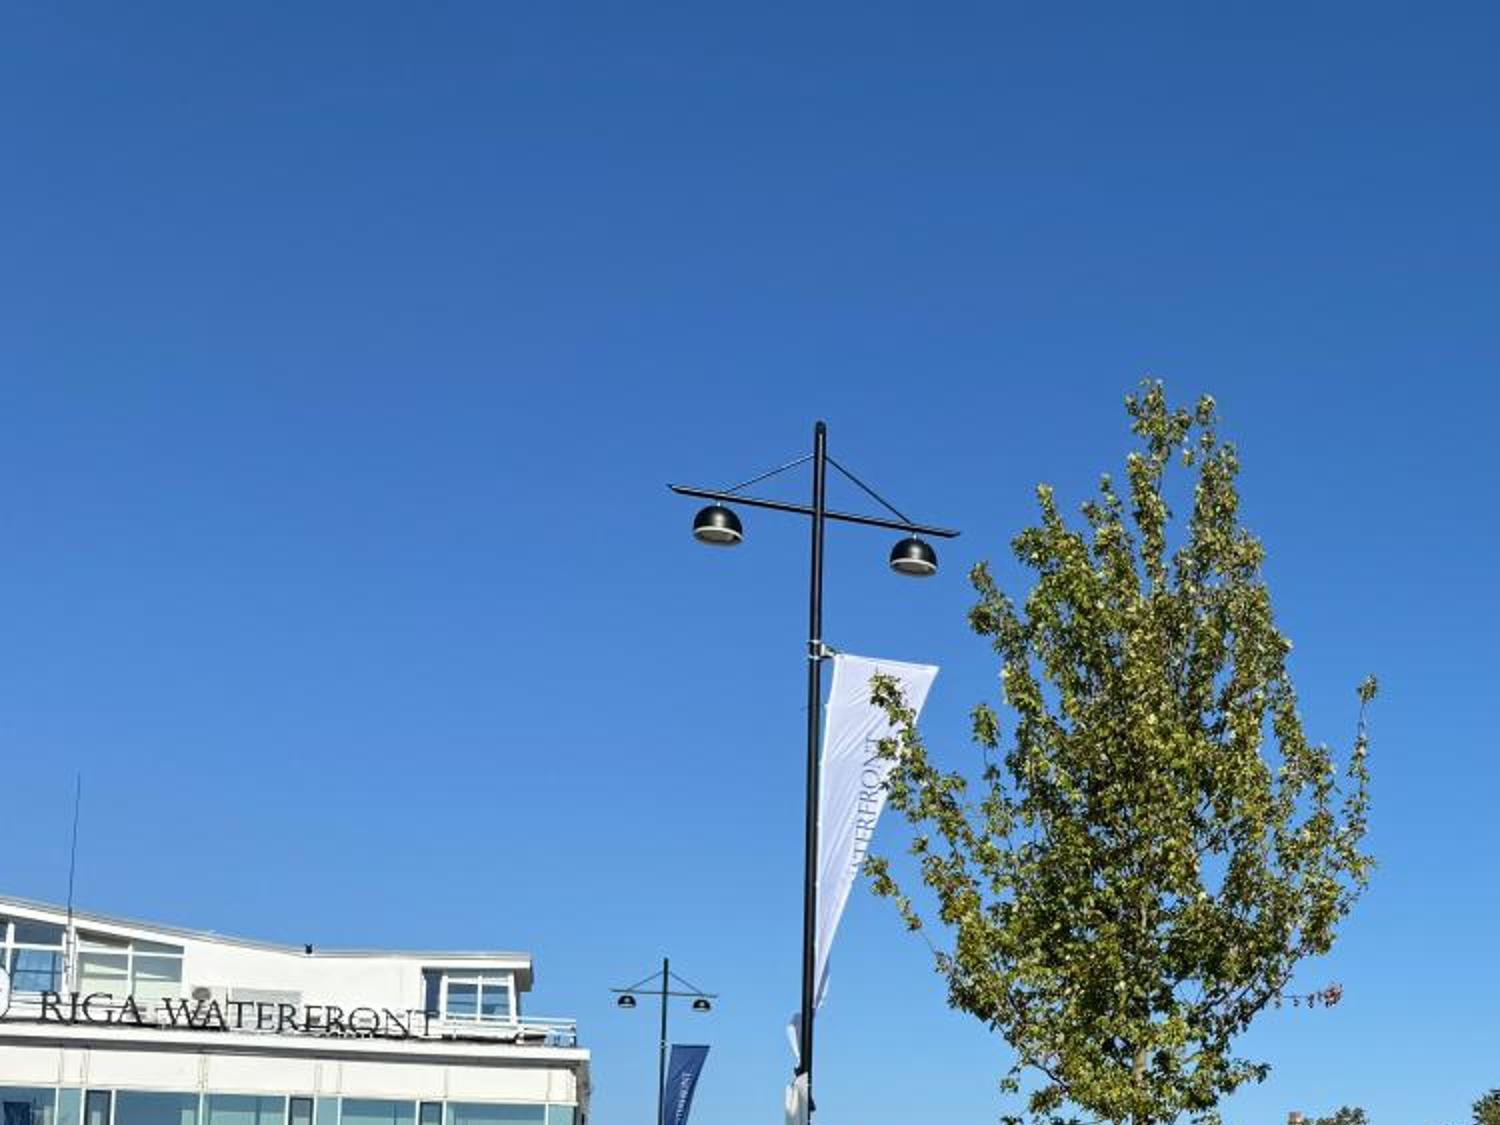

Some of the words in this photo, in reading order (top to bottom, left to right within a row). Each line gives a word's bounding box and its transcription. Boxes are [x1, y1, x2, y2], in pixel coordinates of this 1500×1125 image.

[849, 734, 881, 870] TERFRONT
[40, 991, 144, 1026] RIGA
[161, 997, 440, 1038] WATERFRONT
